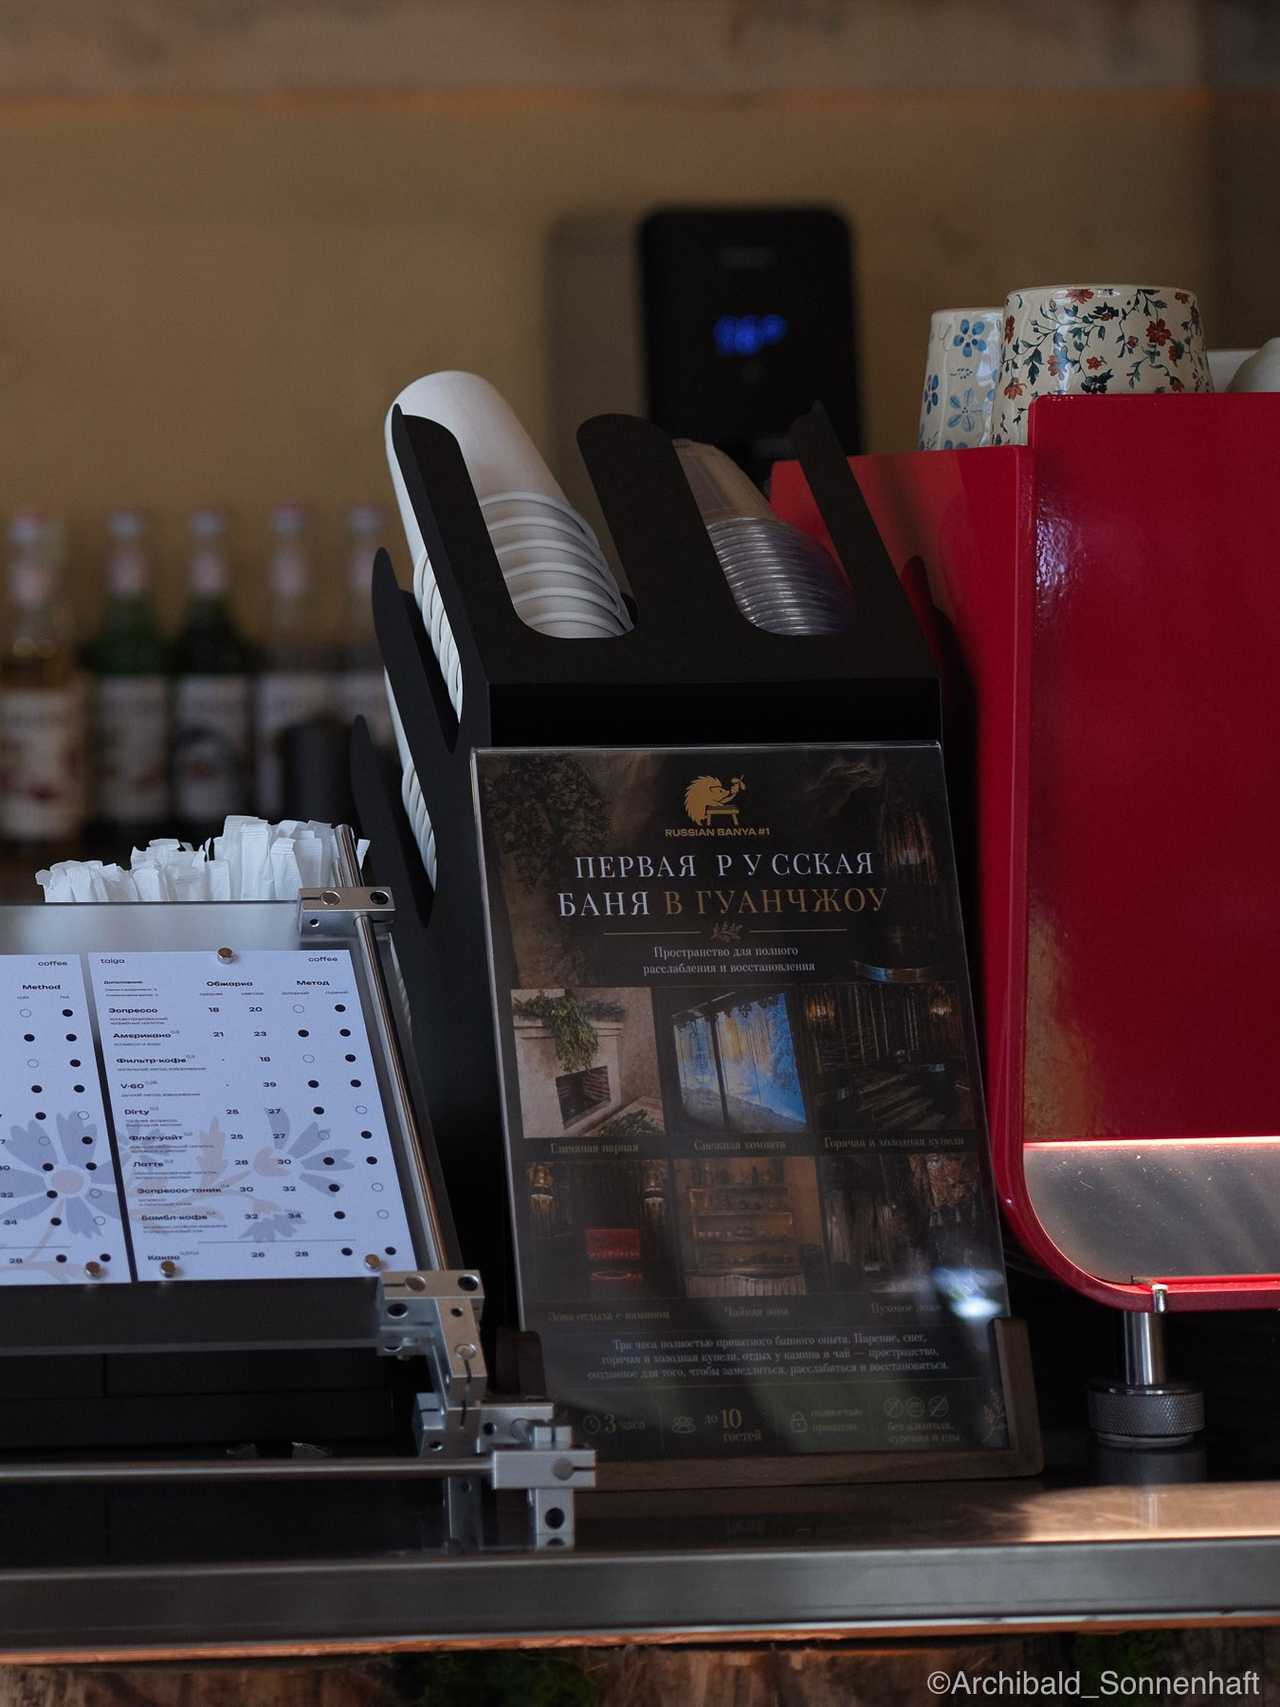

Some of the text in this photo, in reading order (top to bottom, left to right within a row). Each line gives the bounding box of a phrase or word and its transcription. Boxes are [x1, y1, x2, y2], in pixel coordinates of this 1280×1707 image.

[665, 827, 770, 837] RUSSIAN BANYA #1
[575, 852, 874, 878] ПЕРВАЯ РУССКАЯ
[558, 888, 887, 917] БАНЯ В ГУАНЧЖОУ
[654, 946, 798, 959] Пространство для полного
[643, 963, 716, 976] расслабления
[730, 962, 815, 972] восстановления
[141, 1213, 207, 1221] Бамбл-кофе
[605, 1414, 616, 1433] 3
[721, 1408, 742, 1429] 10
